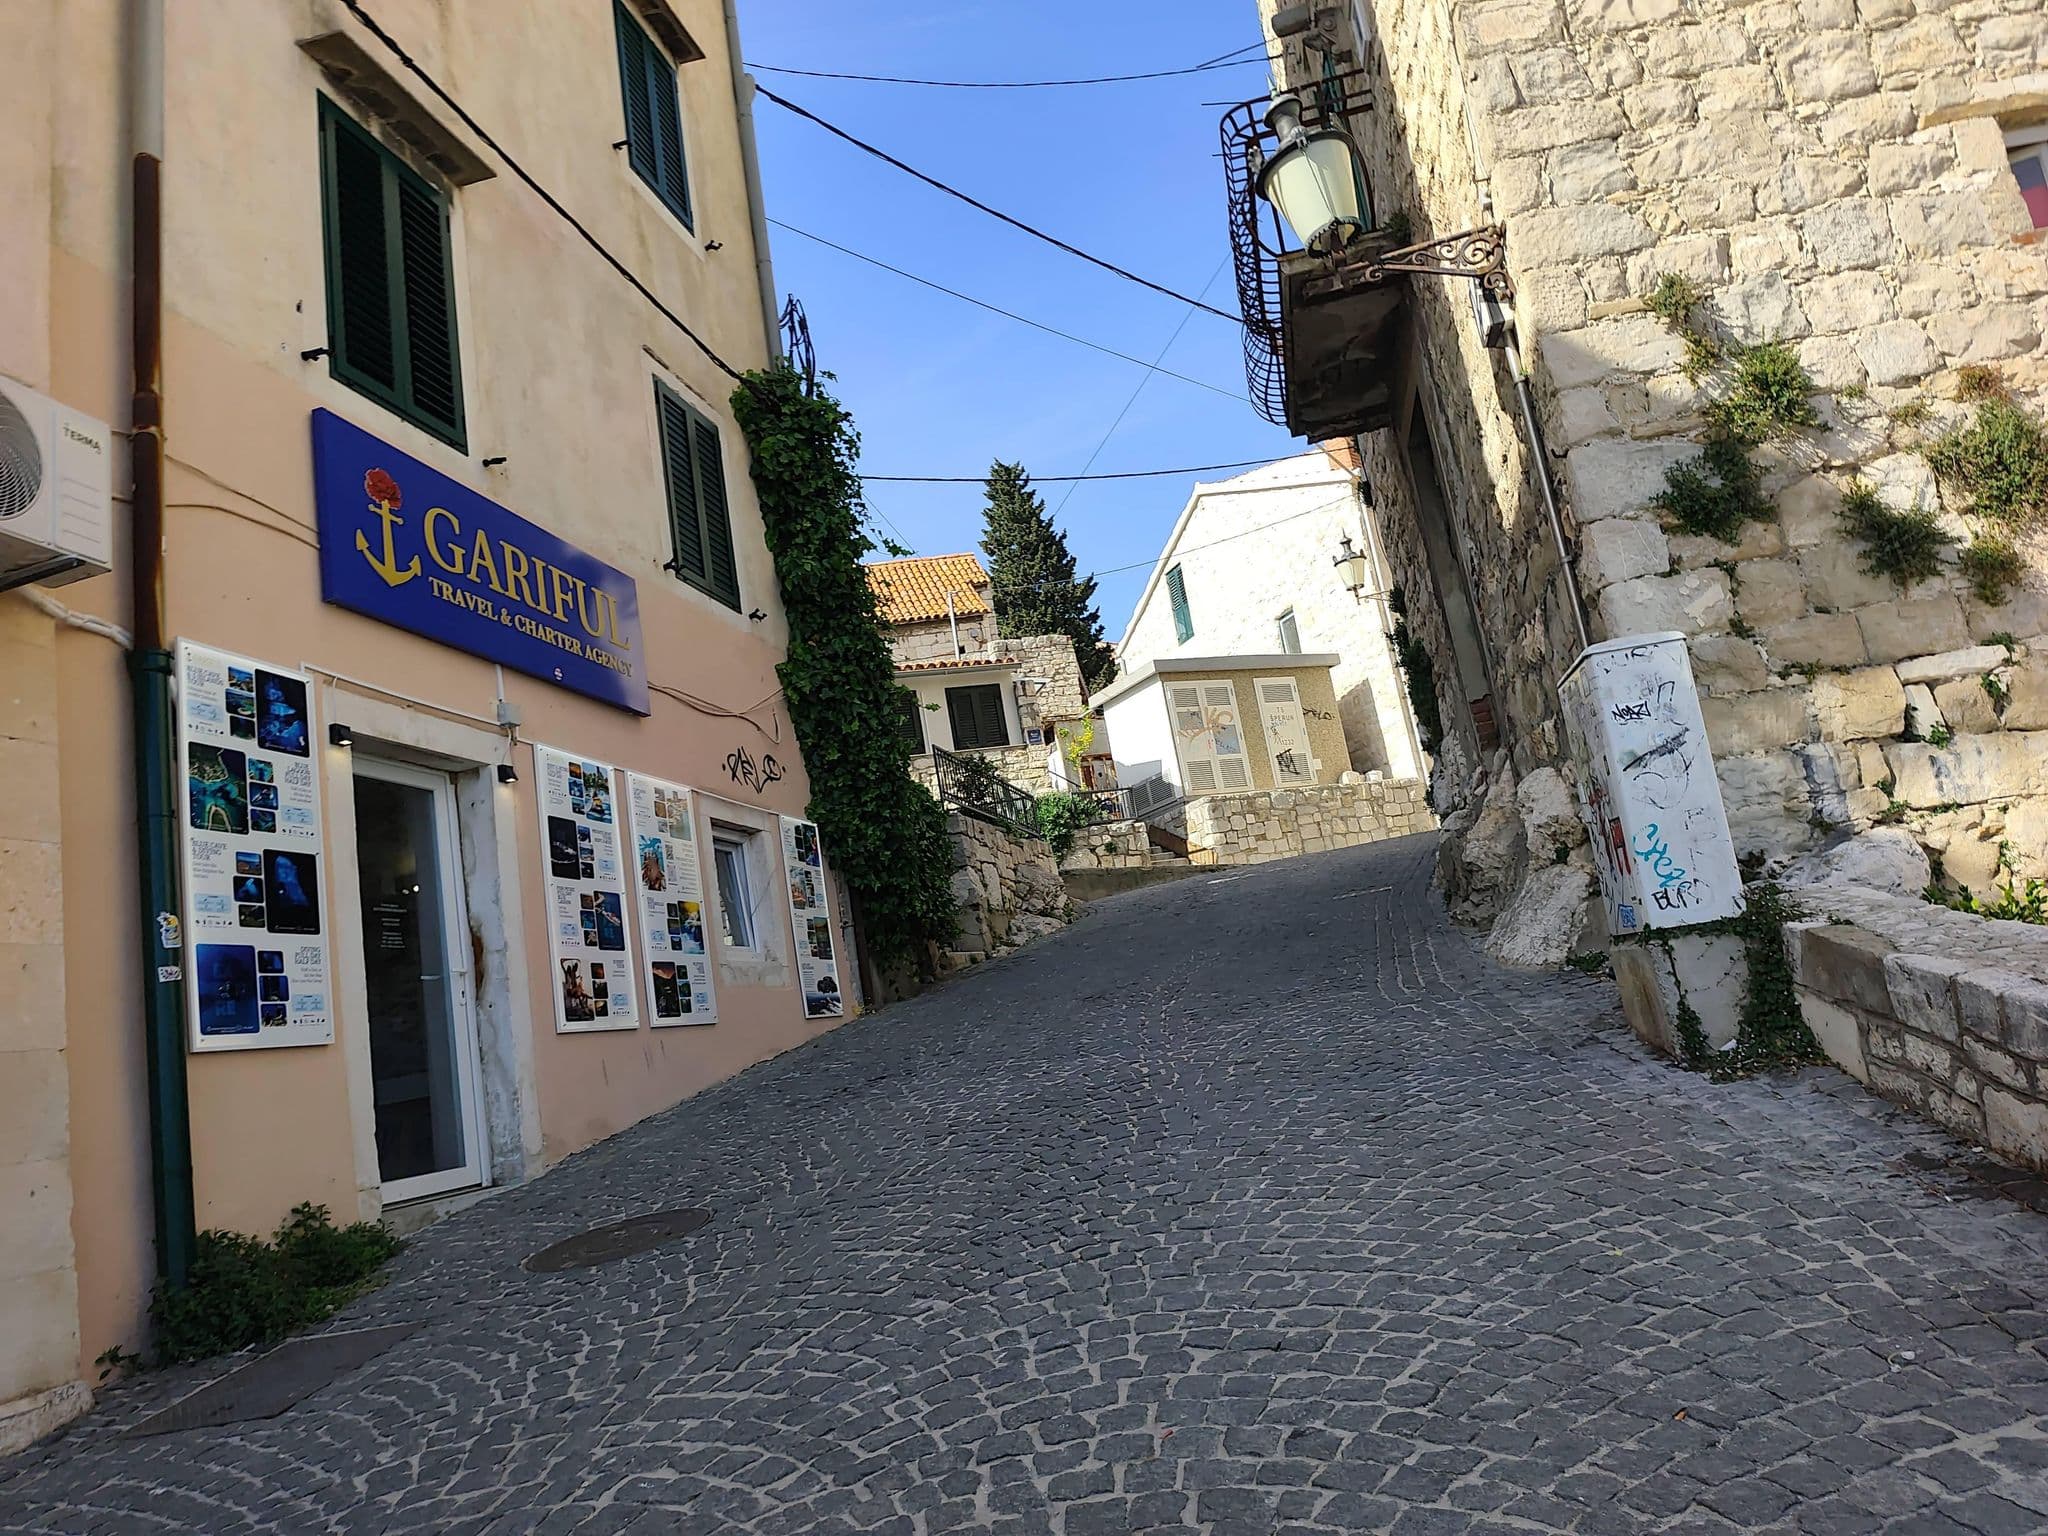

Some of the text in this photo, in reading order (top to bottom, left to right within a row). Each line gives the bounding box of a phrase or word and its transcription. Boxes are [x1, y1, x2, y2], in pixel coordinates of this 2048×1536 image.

[424, 507, 630, 651] GARIFUL
[428, 576, 632, 678] TRAVEL & CHARTER AGENCY
